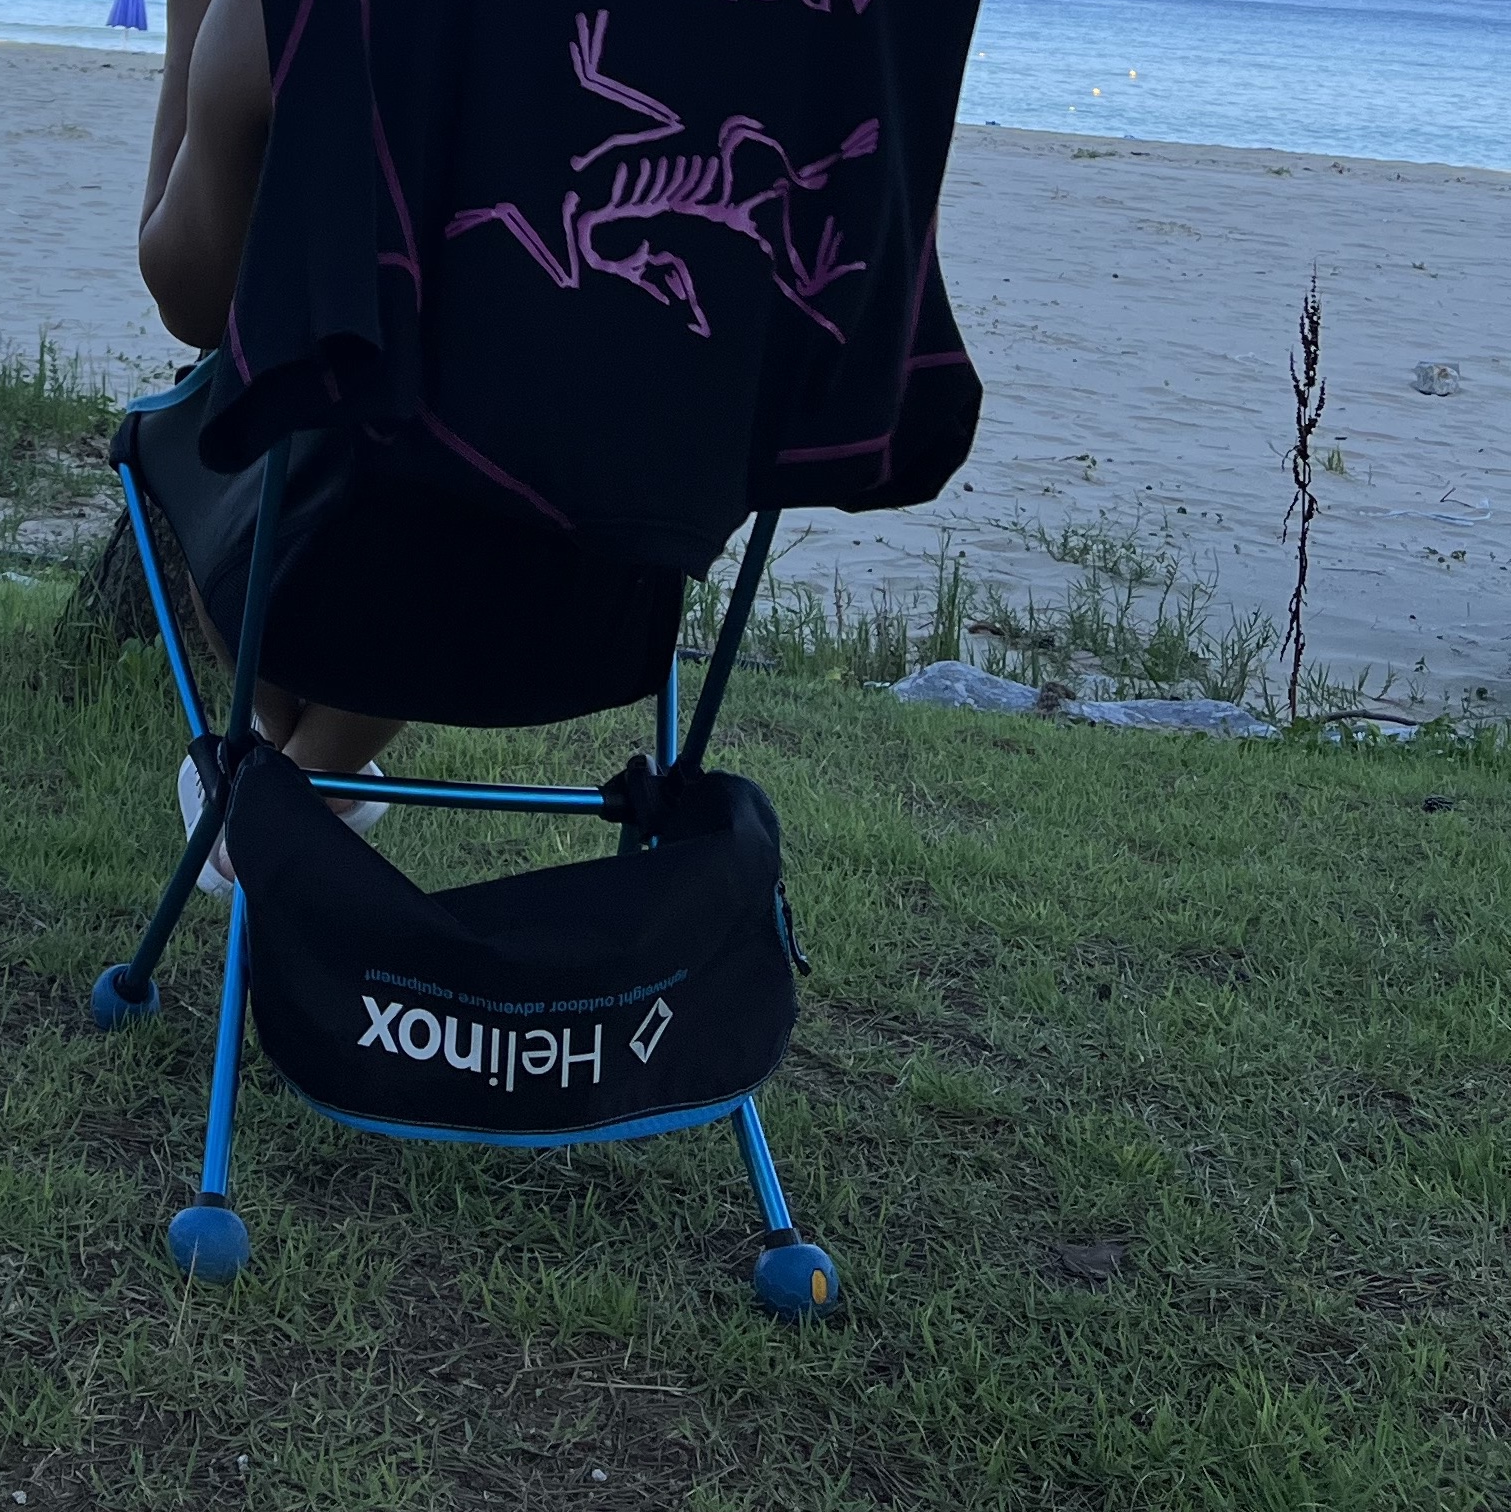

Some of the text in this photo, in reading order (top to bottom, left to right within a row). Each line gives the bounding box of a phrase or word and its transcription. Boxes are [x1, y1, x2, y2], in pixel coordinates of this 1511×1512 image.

[364, 968, 454, 1000] equipment
[458, 992, 545, 1017] adventure
[549, 994, 615, 1015] outdoor
[357, 995, 603, 1093] Helinox
